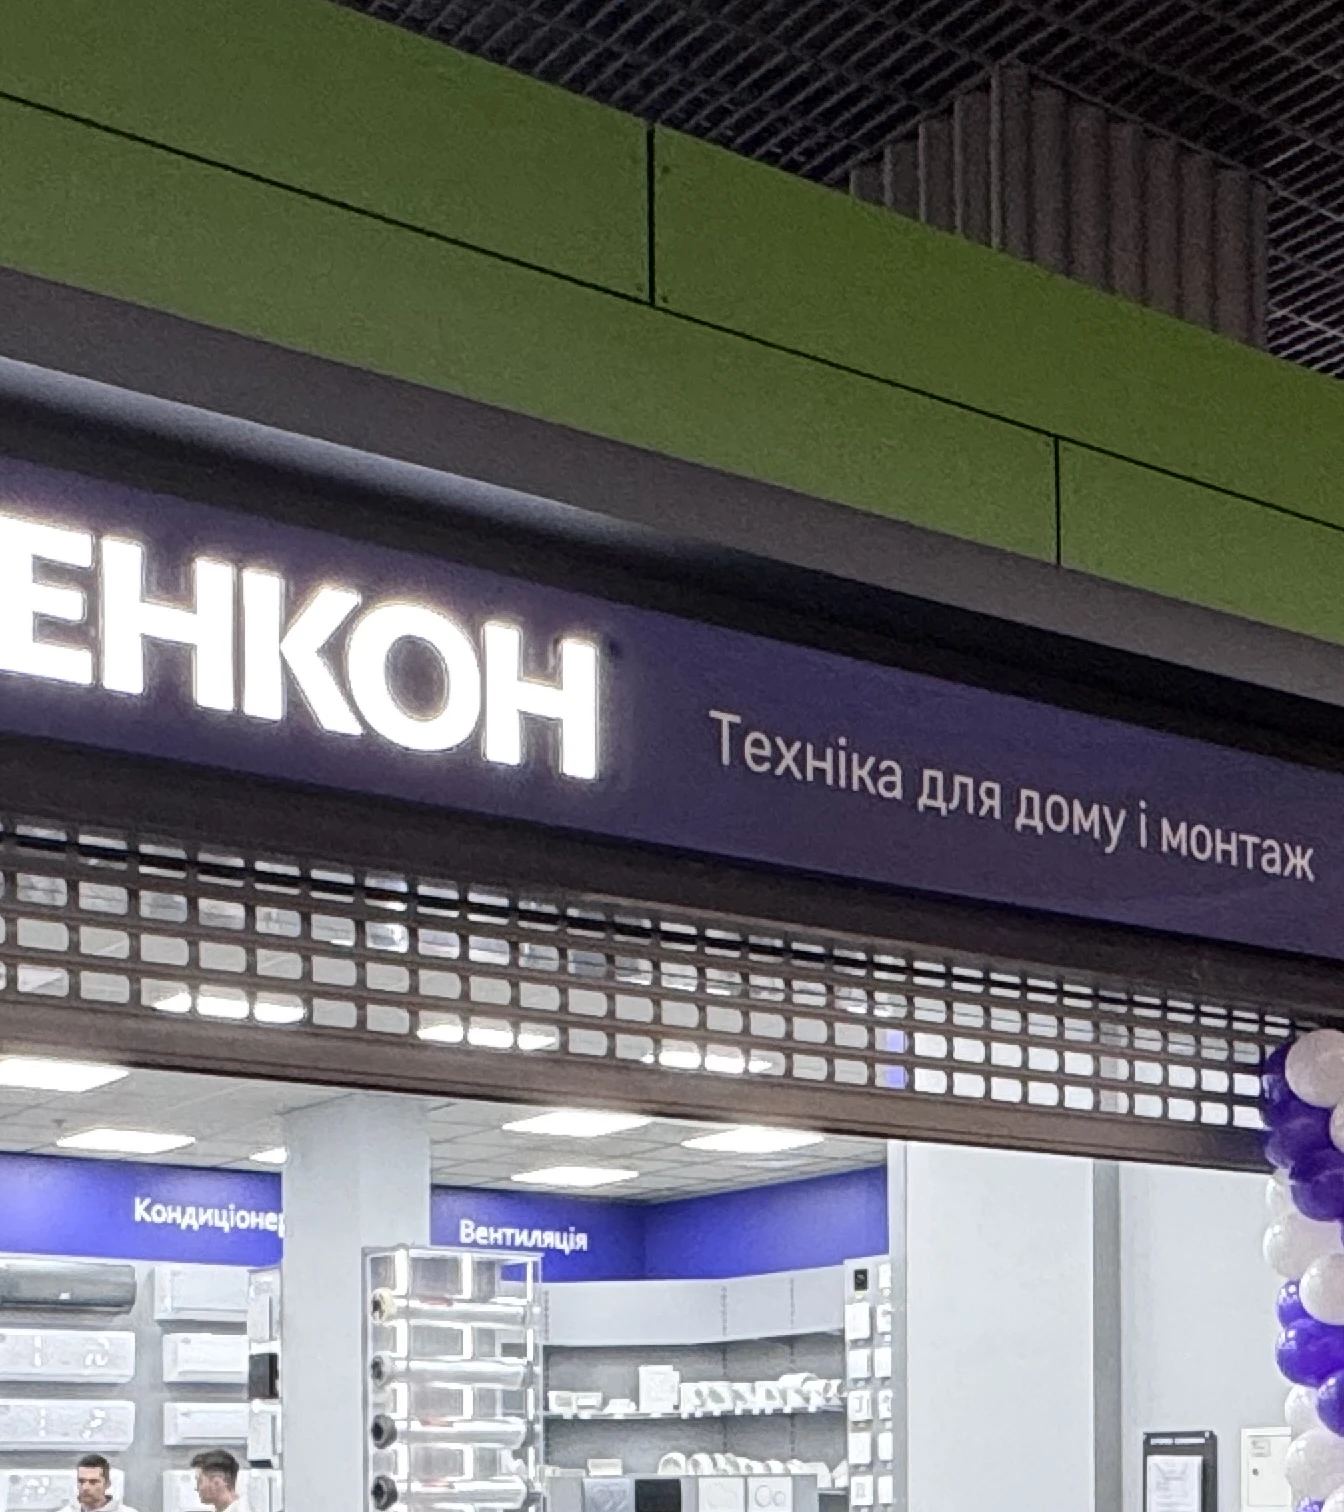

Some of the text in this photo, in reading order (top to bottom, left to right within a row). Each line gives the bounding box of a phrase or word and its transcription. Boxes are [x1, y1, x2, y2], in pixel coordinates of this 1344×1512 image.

[708, 709, 1316, 882] Техніка для дому і монтаж
[459, 1218, 588, 1255] Вентиляція
